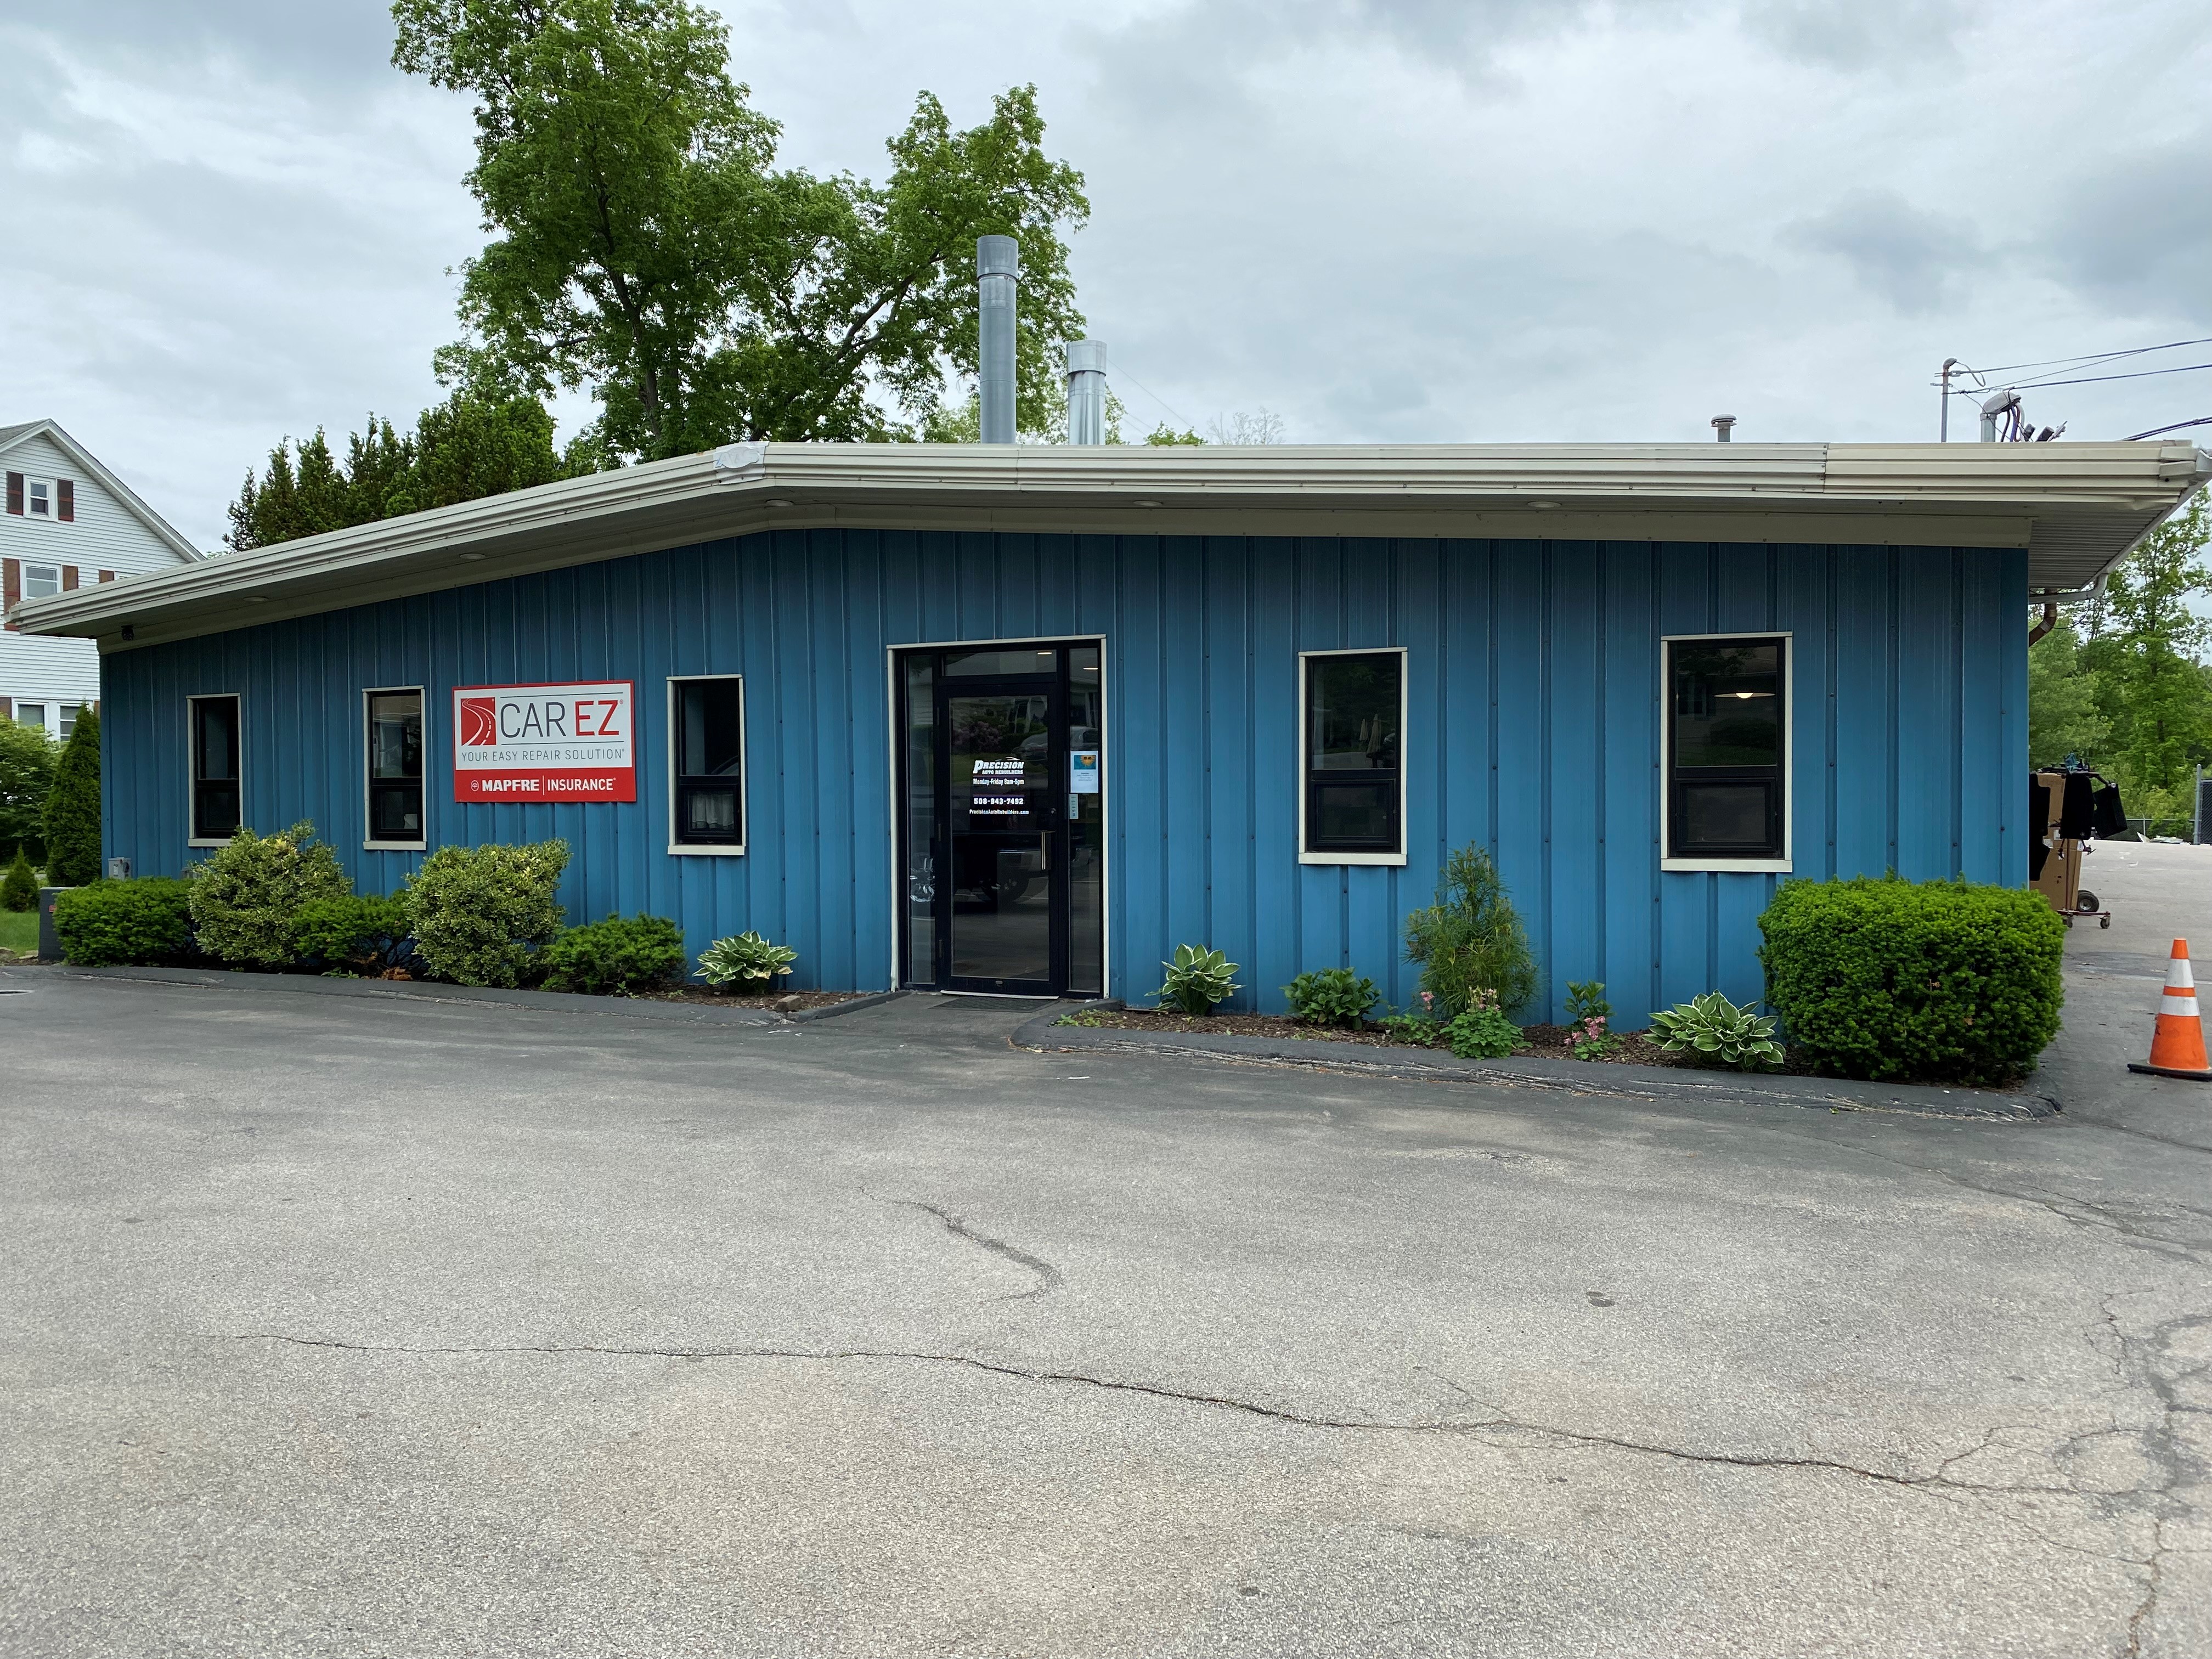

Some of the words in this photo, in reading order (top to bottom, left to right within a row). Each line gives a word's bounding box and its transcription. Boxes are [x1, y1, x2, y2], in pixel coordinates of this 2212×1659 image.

[500, 702, 566, 738] CAR
[575, 699, 619, 736] EZ
[461, 751, 488, 762] YOUR
[493, 751, 518, 761] EASY
[522, 750, 561, 761] REPAIR
[565, 748, 622, 760] SOLUTION
[973, 760, 1025, 774] PRECISION
[482, 779, 540, 792] MAPFRE
[548, 778, 614, 791] INSURANCE
